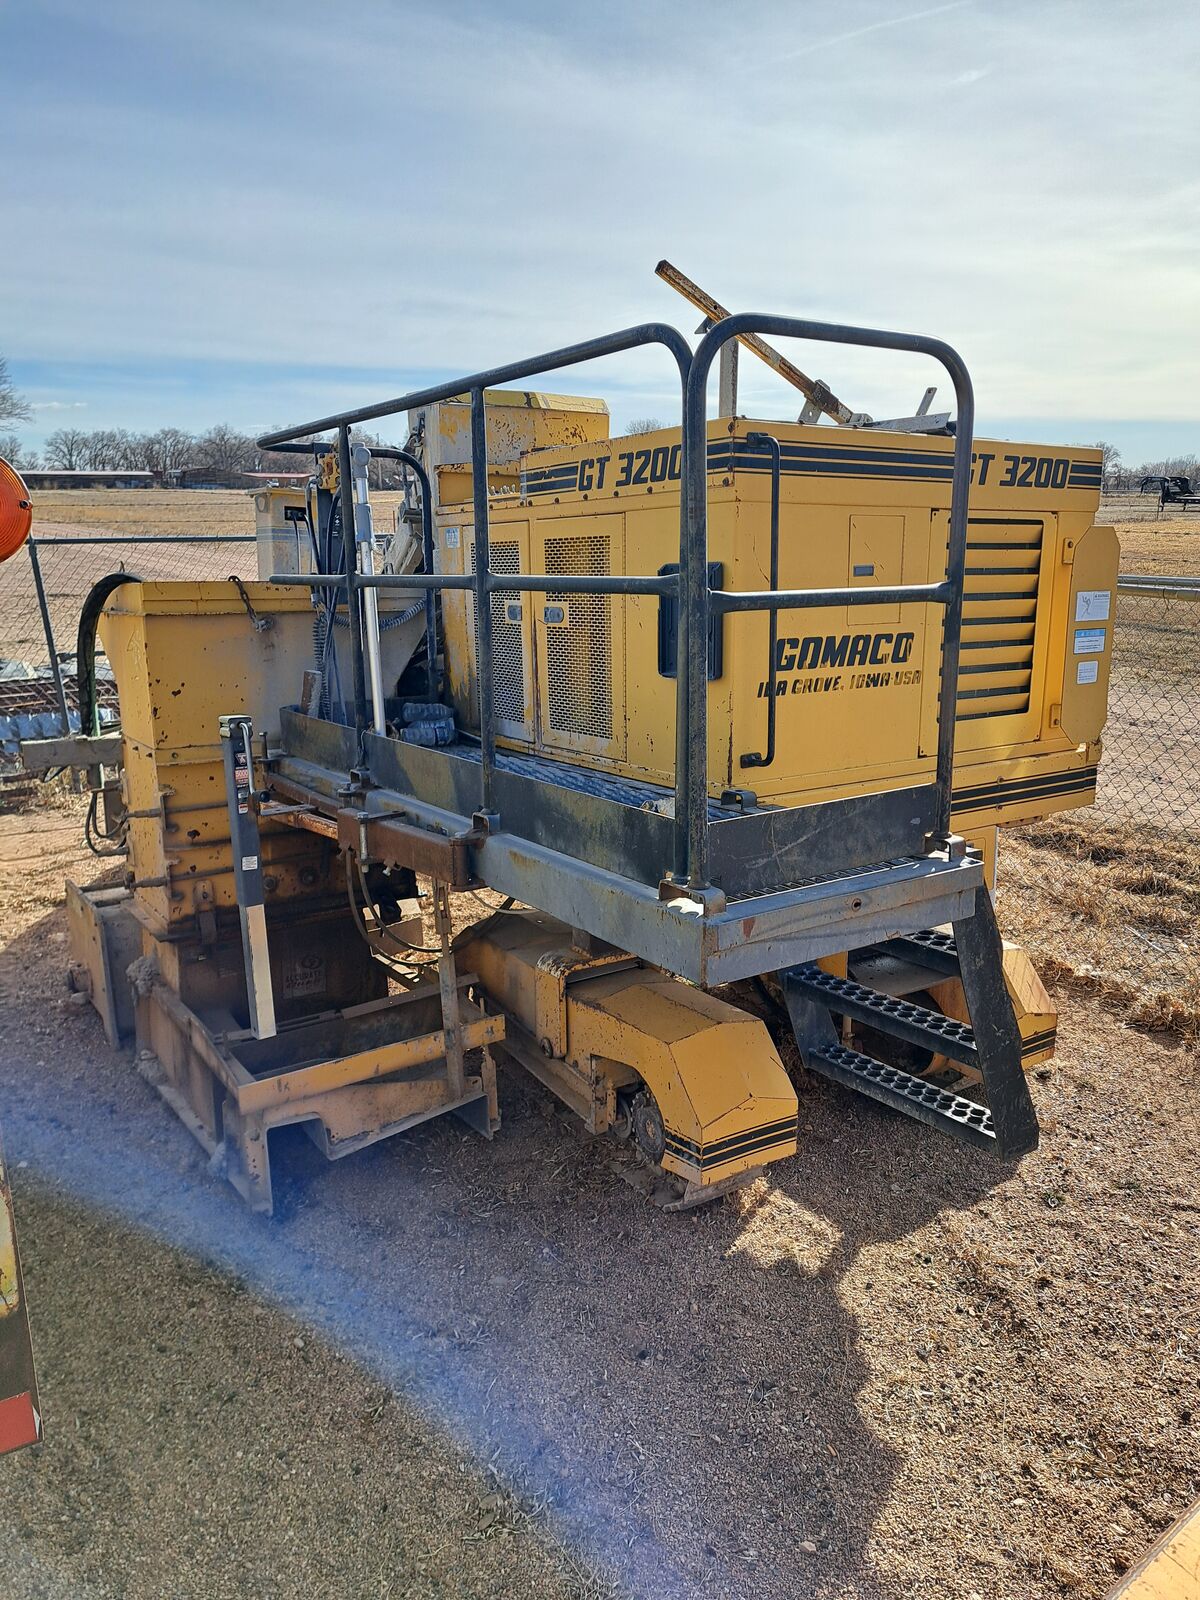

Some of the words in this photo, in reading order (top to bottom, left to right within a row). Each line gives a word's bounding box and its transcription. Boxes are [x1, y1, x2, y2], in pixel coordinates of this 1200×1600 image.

[578, 456, 611, 491] GT
[615, 444, 682, 488] 3200
[999, 455, 1070, 489] 3200
[776, 632, 915, 671] GOMACO
